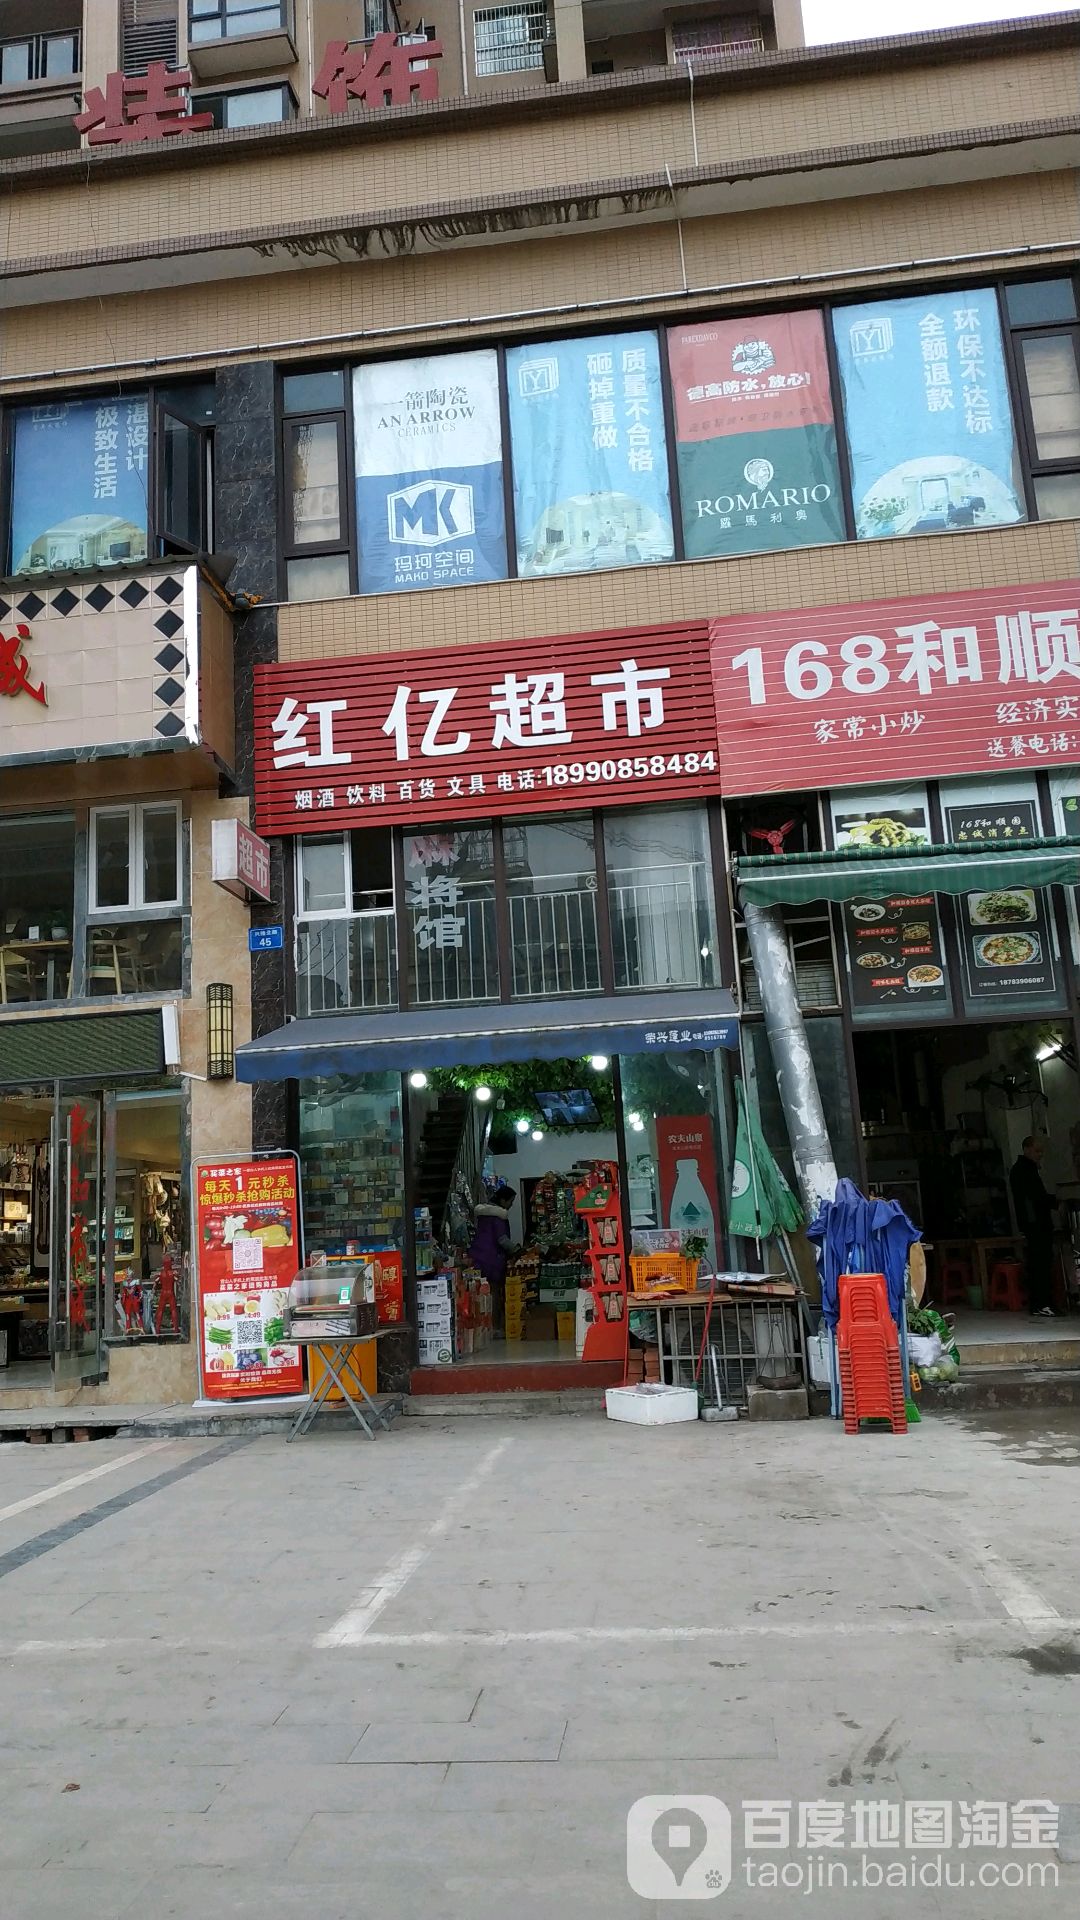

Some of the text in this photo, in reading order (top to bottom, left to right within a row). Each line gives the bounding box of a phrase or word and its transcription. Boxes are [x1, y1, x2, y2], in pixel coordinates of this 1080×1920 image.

[918, 312, 956, 413] 全额退款
[953, 308, 993, 434] 环保不达标
[377, 405, 476, 429] AN ARROW
[586, 352, 619, 450] 砸掉重做
[622, 348, 656, 473] 质量不合格
[397, 423, 456, 438] CERAMICS
[93, 405, 119, 499] 极致生活
[696, 483, 831, 519] ROMARIO
[394, 549, 474, 573] 玛珂空间
[395, 566, 474, 584] MAKO SPACE
[731, 609, 1080, 705] 168和顺
[270, 658, 671, 770] 红亿超市
[814, 710, 925, 744] 家常小炒
[996, 695, 1080, 724] 经济实
[294, 788, 335, 810] 烟酒
[346, 782, 387, 805] 饮料
[397, 779, 436, 801] 百货
[446, 774, 486, 798] 文具
[239, 833, 269, 889] 超市
[259, 937, 272, 947] 45
[667, 1133, 703, 1144] 农夫山泉
[200, 1187, 295, 1206] 惊爆秒杀抢购活动
[204, 1174, 289, 1193] 每天1元秒杀
